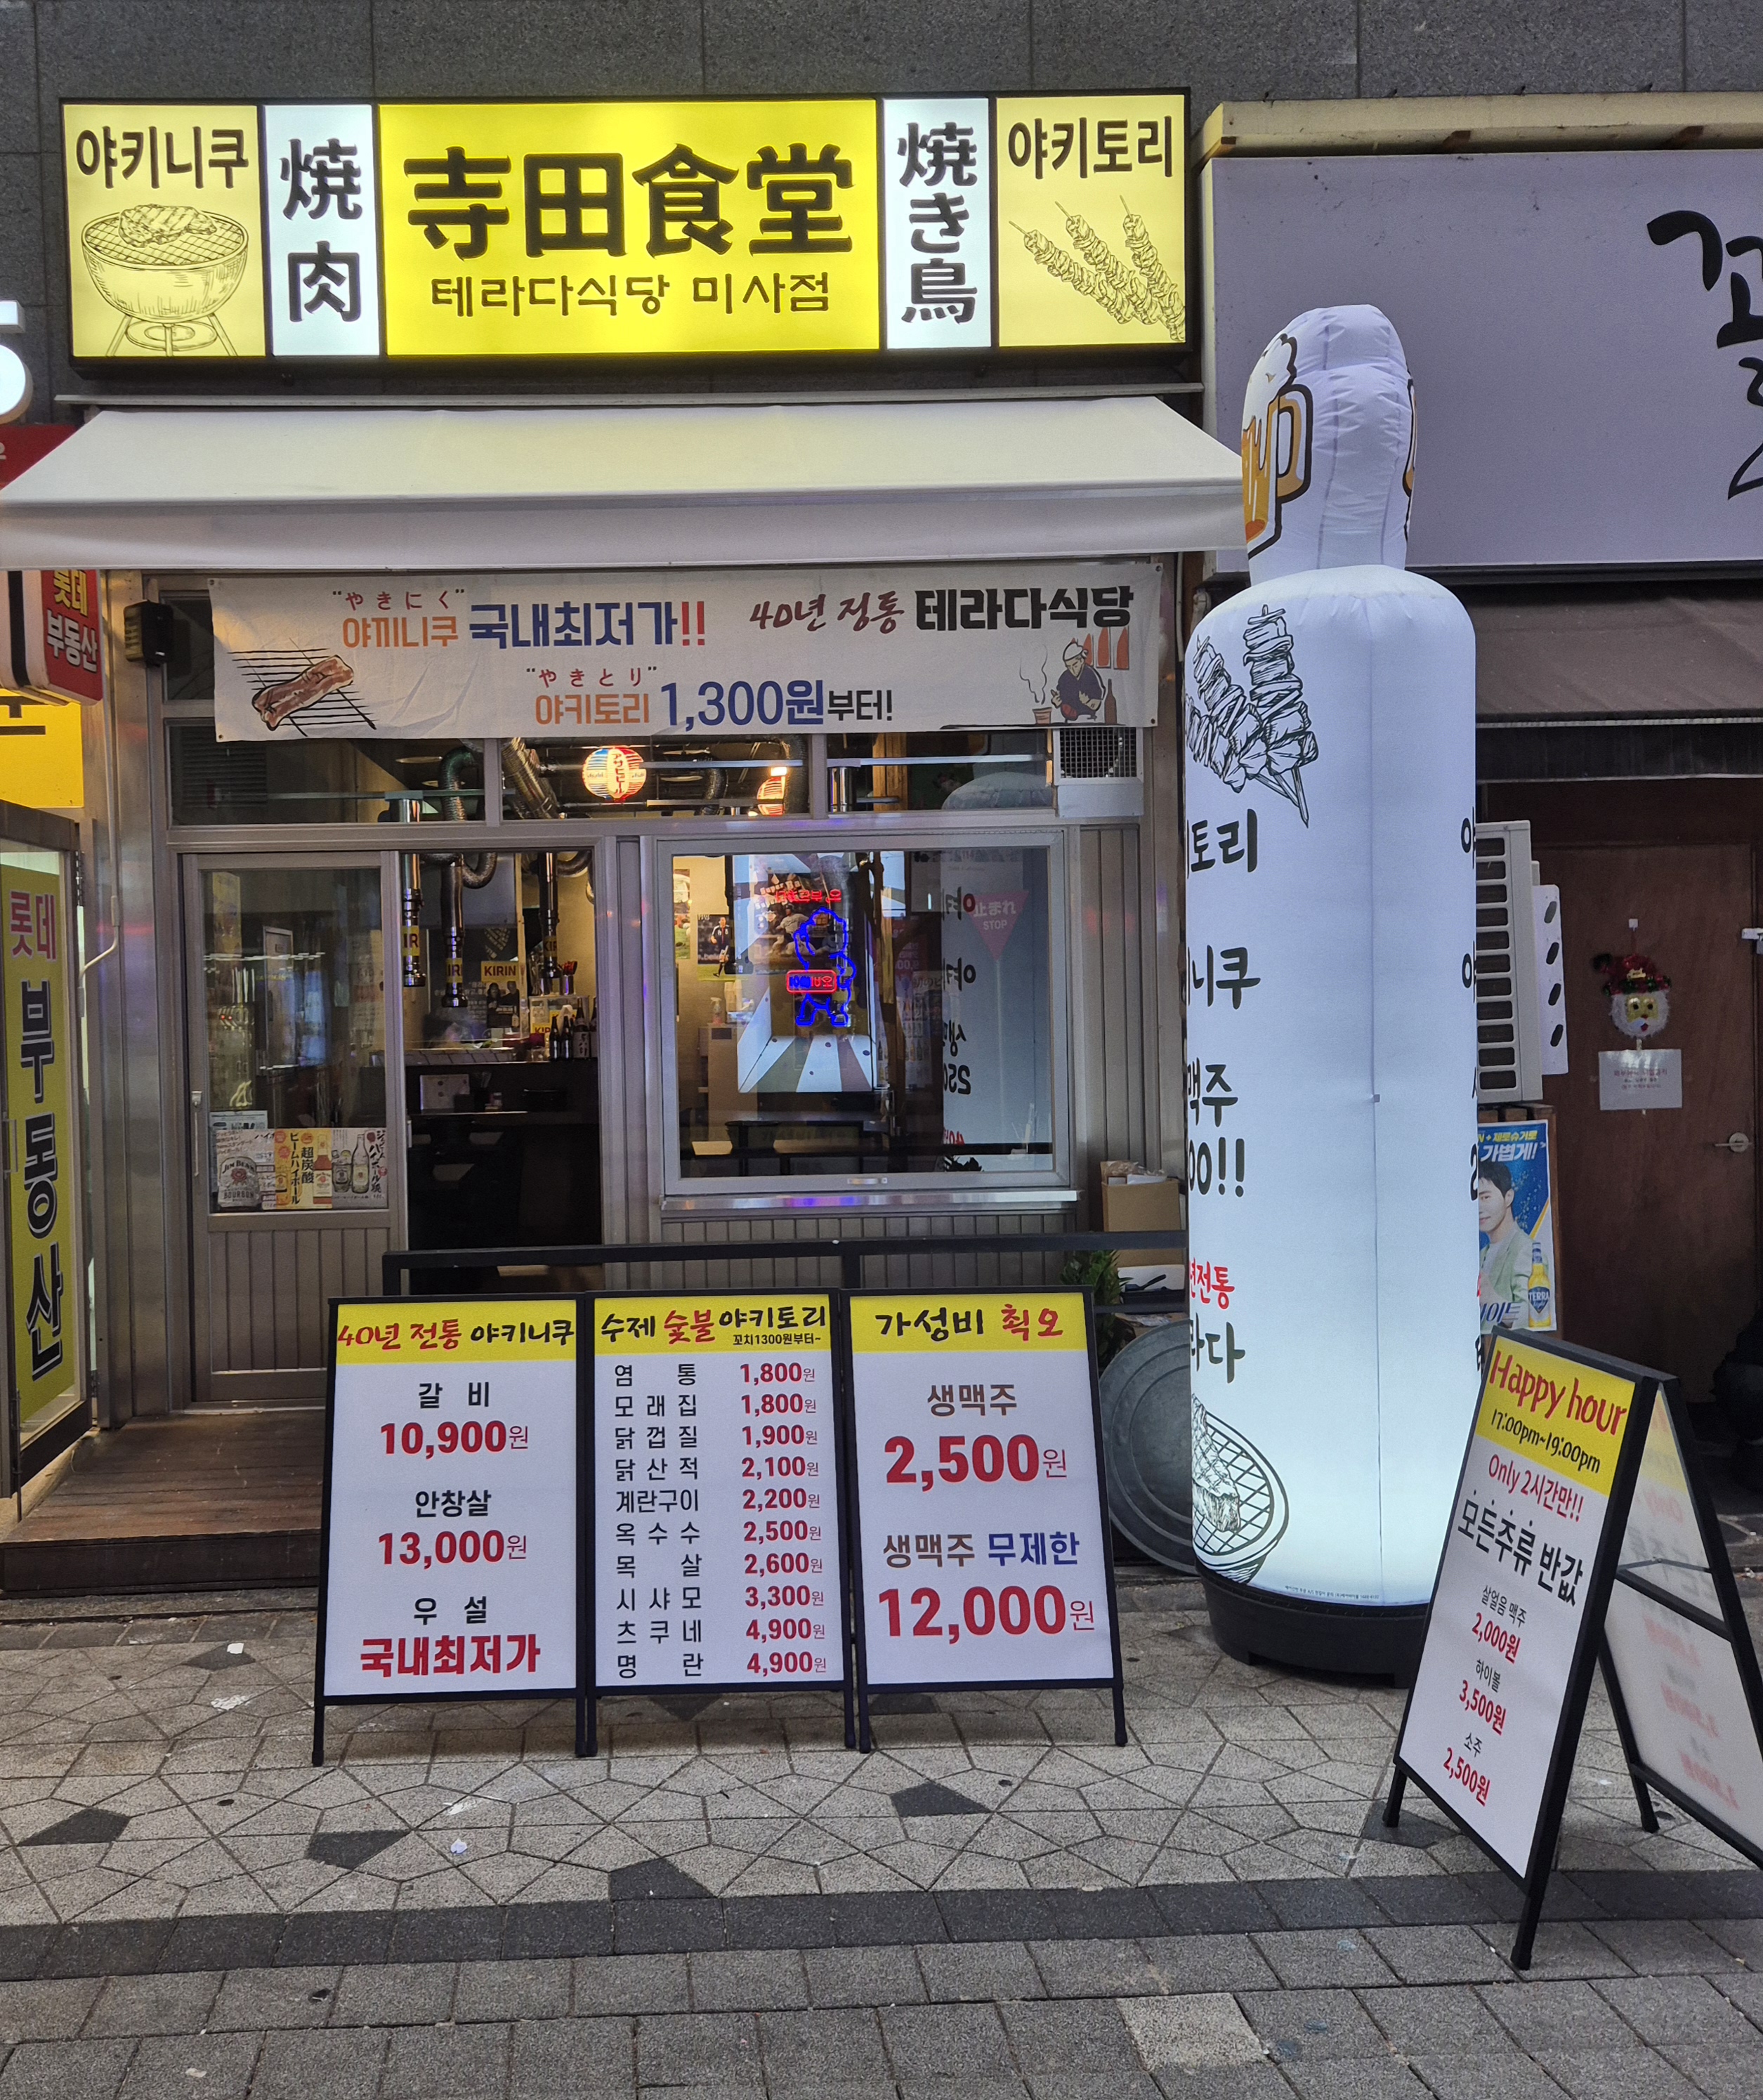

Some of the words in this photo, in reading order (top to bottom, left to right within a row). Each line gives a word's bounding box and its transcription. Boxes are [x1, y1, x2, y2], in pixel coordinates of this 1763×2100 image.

[77, 126, 249, 189] 야키니쿠
[1009, 116, 1173, 179] 야키토리
[403, 143, 853, 260] 寺田食堂
[280, 138, 363, 322] 焼肉
[897, 122, 978, 326] 焼き鳥
[431, 274, 670, 317] 테라다식당
[693, 273, 830, 314] 미사점
[343, 616, 459, 648] 야끼니쿠
[469, 601, 705, 649] 국내최저가!!
[749, 593, 826, 631] 40년
[915, 586, 1134, 631] 테라다식당
[46, 608, 98, 673] 부동산
[535, 693, 650, 725] 야키토리
[1187, 808, 1258, 879] 토리
[10, 889, 58, 961] 롯데
[974, 900, 1017, 917] 止まれ
[983, 919, 1008, 931] STOP
[484, 965, 516, 976] KIRIN
[1187, 945, 1261, 1010] 니쿠
[1480, 1142, 1539, 1163] 가볍게!
[1493, 1130, 1538, 1143] 제로슈거로
[20, 978, 64, 1382] 부동산
[301, 1146, 315, 1184] 超炭酸
[1528, 1291, 1550, 1301] TERRA
[338, 1323, 401, 1350] 40년
[409, 1319, 462, 1350] 전통
[471, 1320, 575, 1346] 야키니쿠
[601, 1313, 655, 1342] 수제
[663, 1309, 716, 1345] 숯불
[719, 1306, 826, 1329] 야키토리
[875, 1307, 984, 1341] 가성비
[1001, 1304, 1063, 1341] 쵝오
[740, 1362, 815, 1386] 1,800원
[1489, 1350, 1566, 1419] Happy
[1566, 1377, 1627, 1436] hour
[741, 1393, 817, 1417] 1,800원
[927, 1384, 1017, 1417] 생맥주
[380, 1420, 528, 1459] 10,900원
[742, 1424, 818, 1448] 1,900원
[742, 1456, 819, 1480] 2,100원
[884, 1434, 1068, 1492] 2,500원
[415, 1490, 492, 1518] 안창살
[616, 1489, 699, 1513] 계란구이
[742, 1488, 820, 1512] 2,200원
[1488, 1454, 1521, 1494] Only
[1520, 1469, 1585, 1523] 2시간만!!
[378, 1530, 527, 1570] 13,000원
[743, 1520, 822, 1545] 2,500원
[883, 1534, 975, 1568] 생맥주
[988, 1531, 1080, 1567] 무제한
[744, 1552, 823, 1578] 2,600원
[1457, 1499, 1536, 1578] 모든주류
[1537, 1542, 1584, 1607] 반값
[745, 1584, 824, 1610] 3,300원
[879, 1584, 1095, 1645] 12,000원
[1481, 1584, 1508, 1617] 살얼음
[1507, 1601, 1526, 1628] 맥주
[746, 1617, 825, 1643] 4,900원
[1472, 1611, 1521, 1665] 2,000원
[360, 1634, 541, 1678] 국내최저가
[747, 1651, 827, 1677] 4,900원
[1476, 1658, 1502, 1693] 하이볼
[1458, 1679, 1507, 1736] 3,500원
[1463, 1731, 1483, 1759] 소주
[1443, 1747, 1491, 1807] 2,500원
